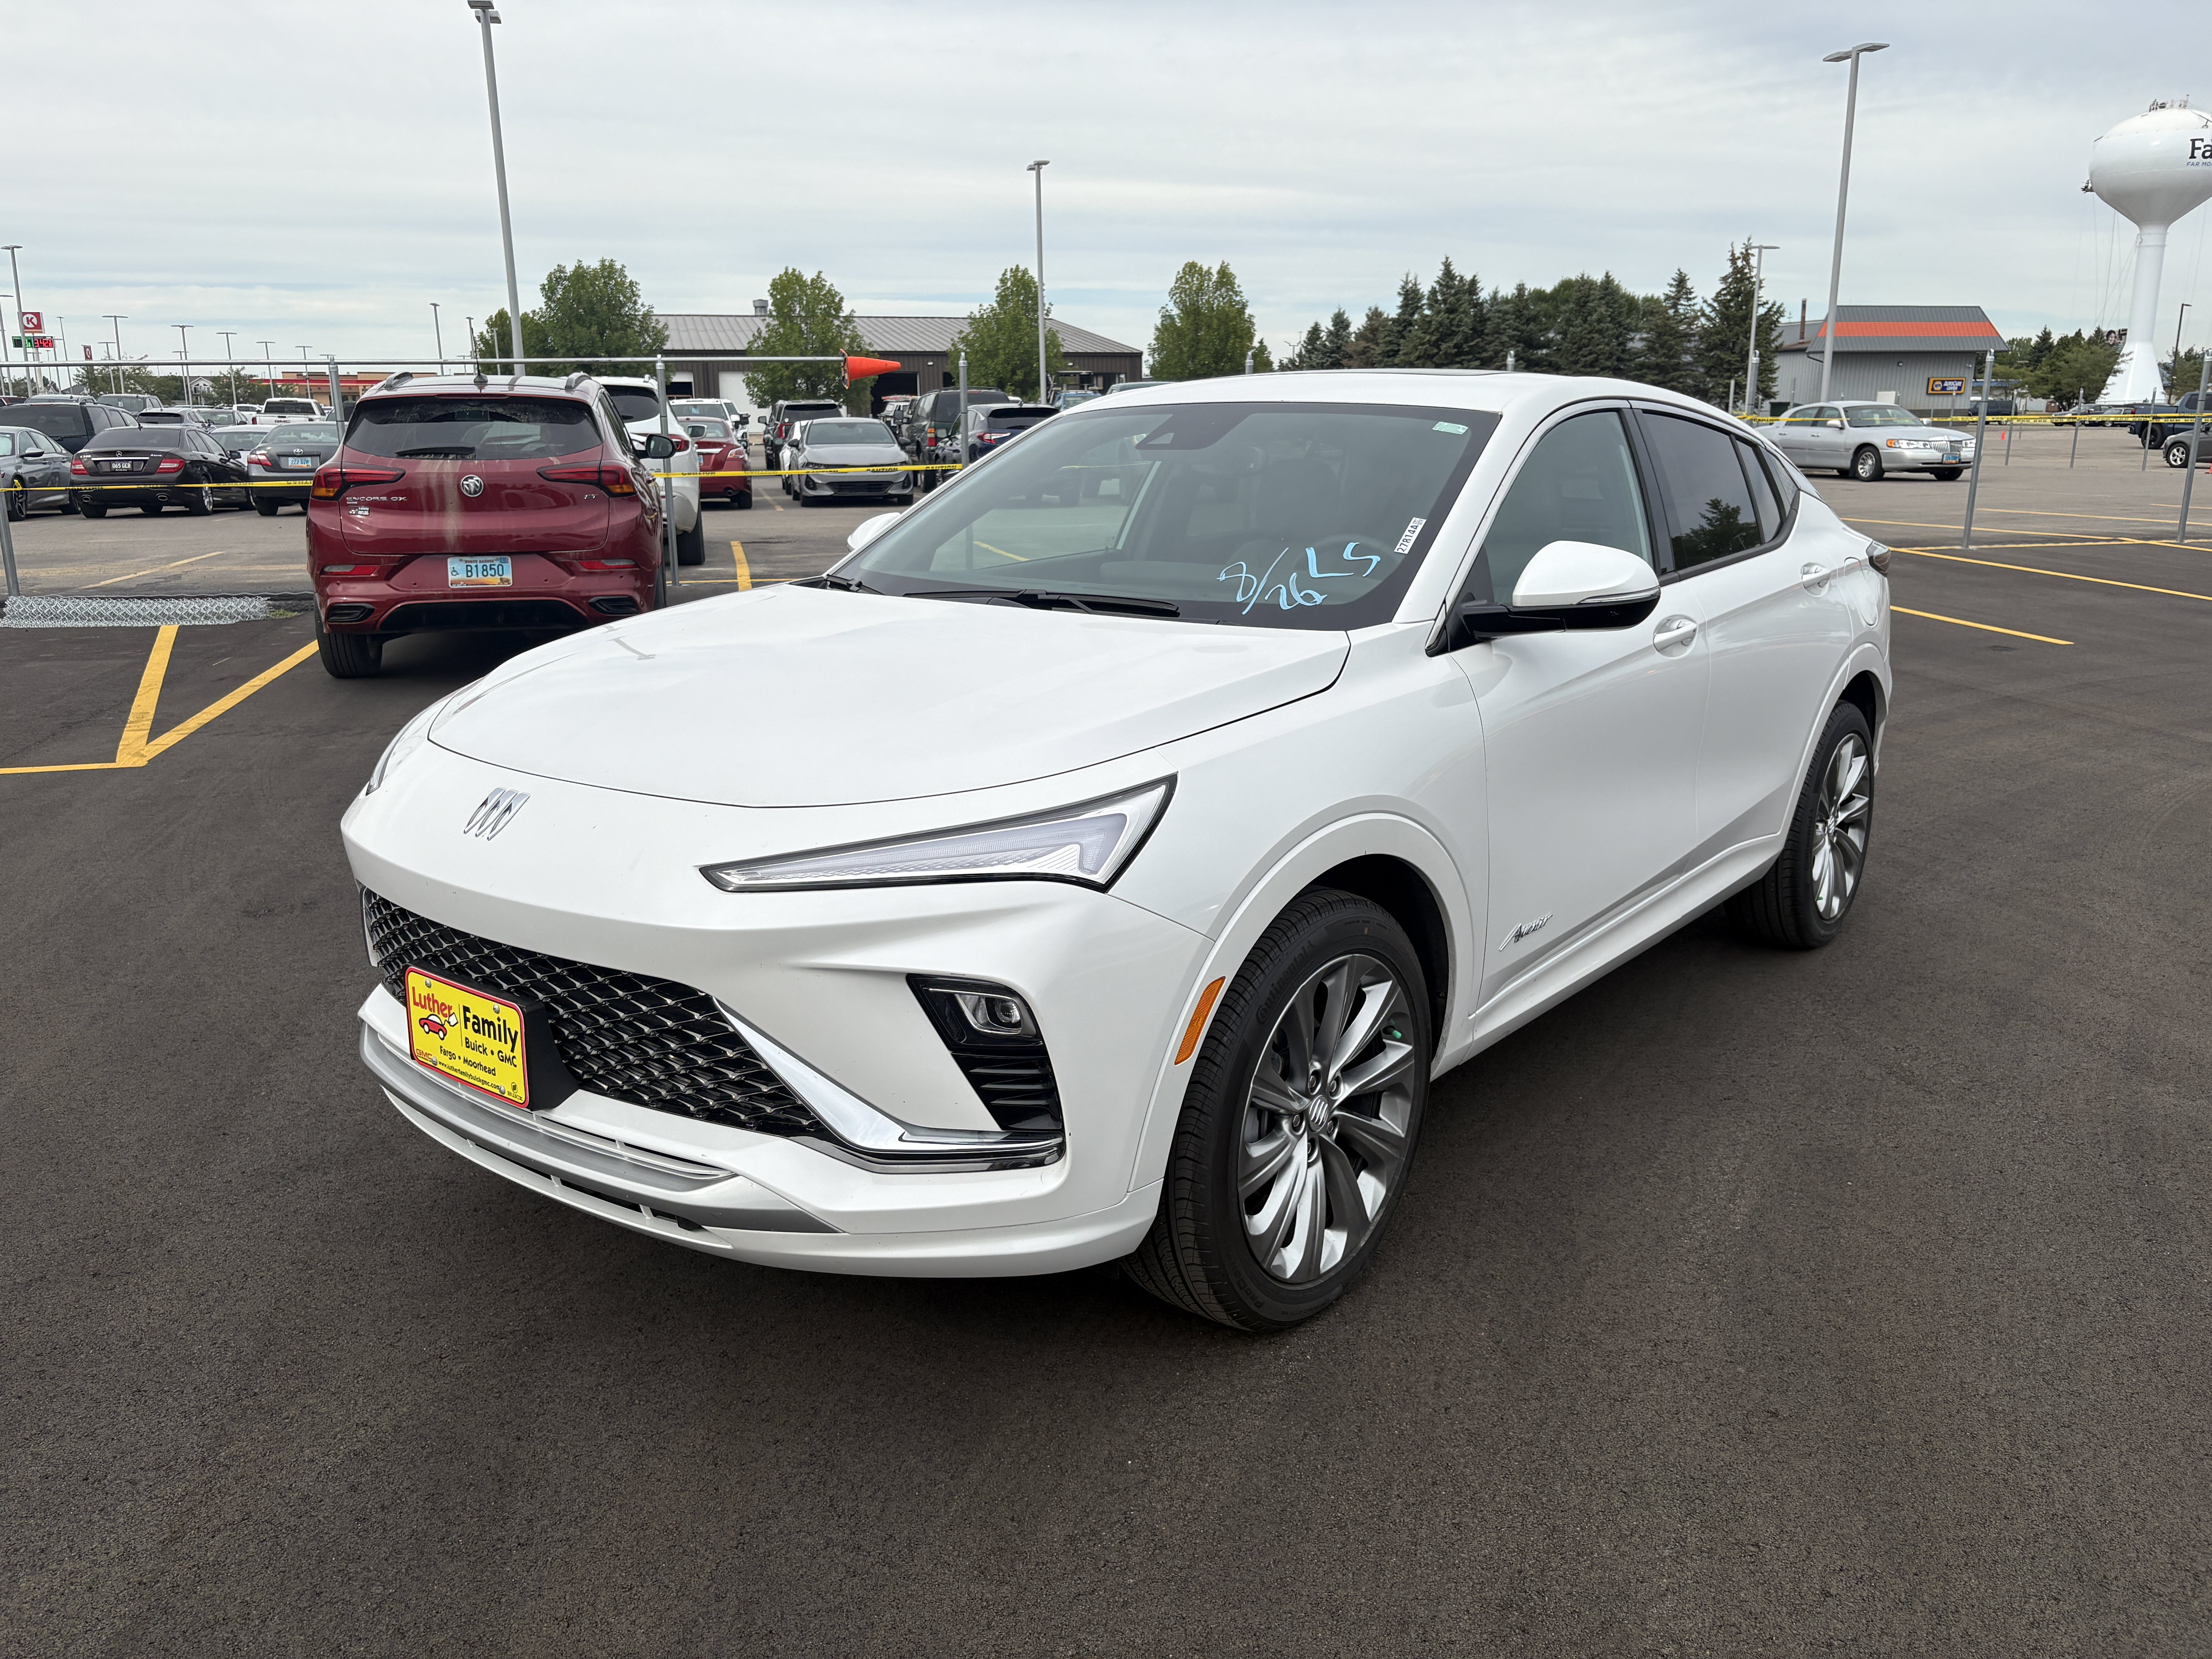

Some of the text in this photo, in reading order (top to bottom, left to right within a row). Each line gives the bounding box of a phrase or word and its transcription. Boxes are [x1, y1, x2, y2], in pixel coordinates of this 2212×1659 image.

[26, 317, 37, 328] K
[465, 564, 504, 578] B1850
[412, 986, 452, 1018] Luther
[463, 1005, 519, 1053] Family
[416, 1048, 433, 1060] GMC
[440, 1045, 456, 1060] Fargo
[463, 1055, 496, 1076] Moorhead
[465, 1036, 517, 1068] Buick GMC
[507, 1091, 523, 1101] BUICK
